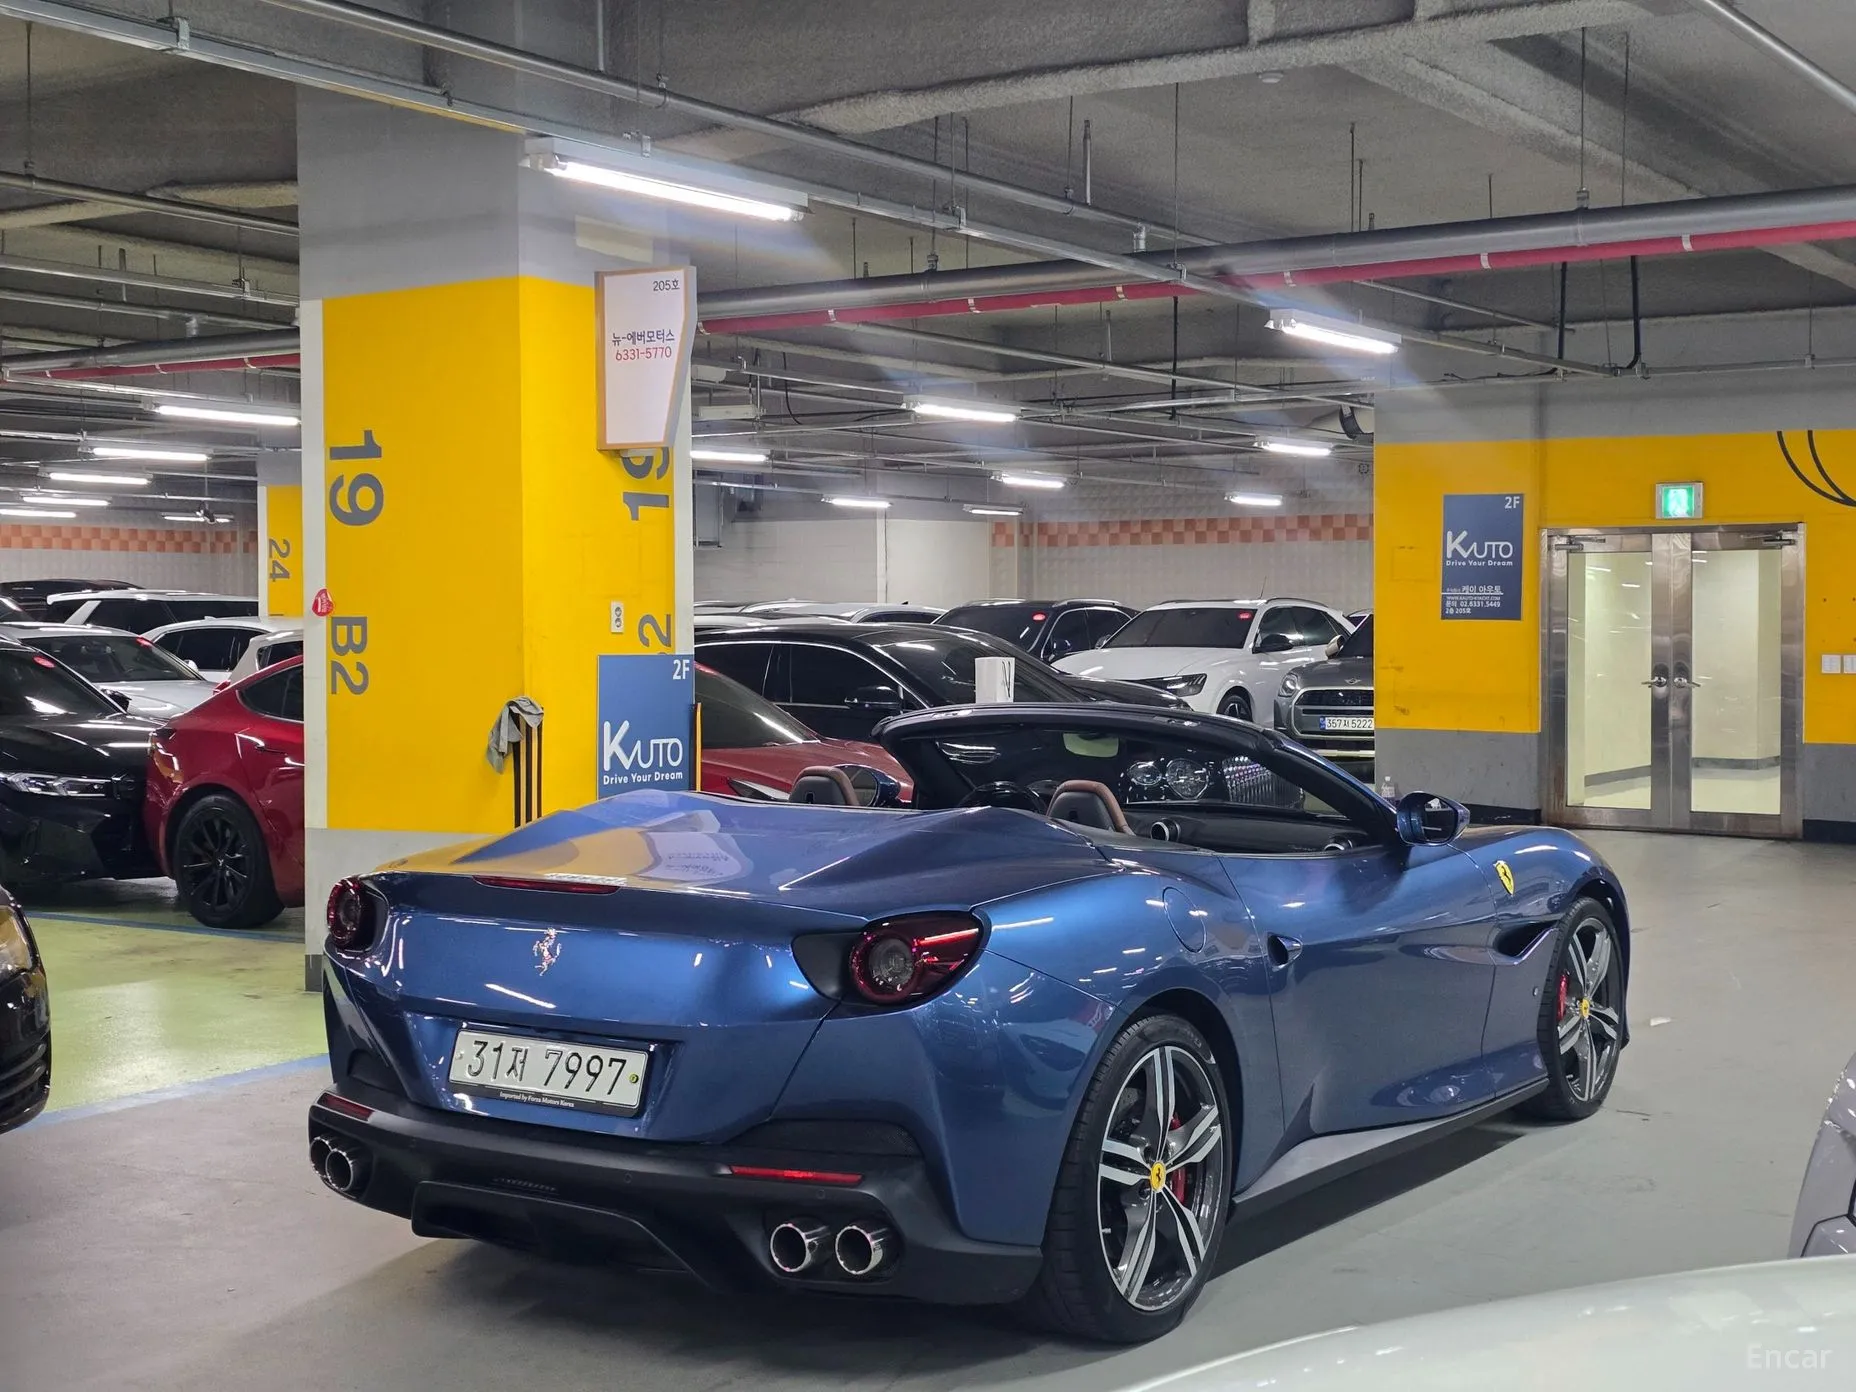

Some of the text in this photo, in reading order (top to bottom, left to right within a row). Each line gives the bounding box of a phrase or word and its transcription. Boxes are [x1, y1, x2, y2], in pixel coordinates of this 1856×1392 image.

[653, 279, 680, 292] 205호
[612, 329, 675, 347] 뉴-에버모터스
[615, 346, 672, 361] 6331-5770
[329, 429, 384, 526] 19
[1504, 496, 1520, 509] 2F
[269, 538, 291, 582] 24
[638, 614, 671, 654] 2
[330, 616, 370, 695] B2
[672, 659, 690, 680] 2F
[1351, 719, 1373, 729] 5222
[603, 771, 683, 785] Drive Your Dream
[467, 1039, 627, 1096] 31저 7997
